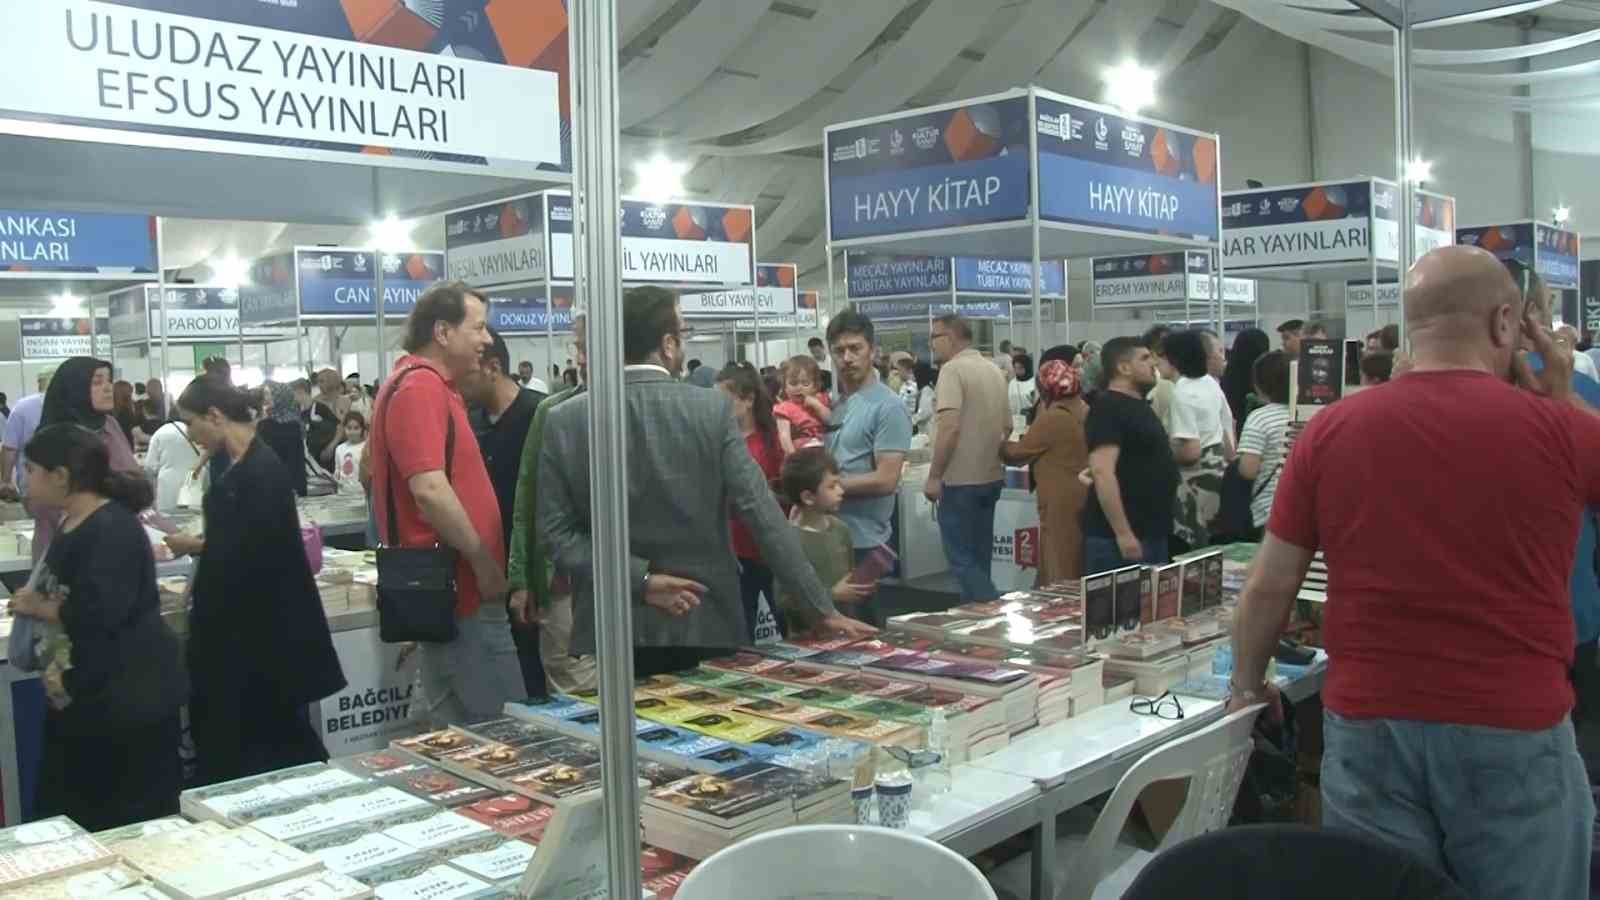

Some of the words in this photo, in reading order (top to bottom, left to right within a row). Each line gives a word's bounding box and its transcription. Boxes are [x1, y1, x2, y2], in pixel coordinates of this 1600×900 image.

[66, 9, 262, 74] ULUDAZ
[273, 40, 466, 100] YAYINLARI
[97, 67, 240, 121] EFSUS
[250, 86, 448, 143] YAYINLARI
[855, 187, 920, 222] HAYY
[928, 176, 1001, 213] KİTAP
[1089, 181, 1134, 216] HAYY
[1137, 186, 1179, 221] KİTAP
[1, 240, 70, 261] NLARI
[1260, 227, 1366, 253] YAYINLARI
[478, 247, 546, 277] YAYINLARI
[640, 251, 718, 273] YAYINLARI
[334, 286, 370, 304] CAN
[373, 286, 425, 304] AYIN
[168, 315, 222, 330] PARODİ
[500, 311, 537, 326] DOKUZ
